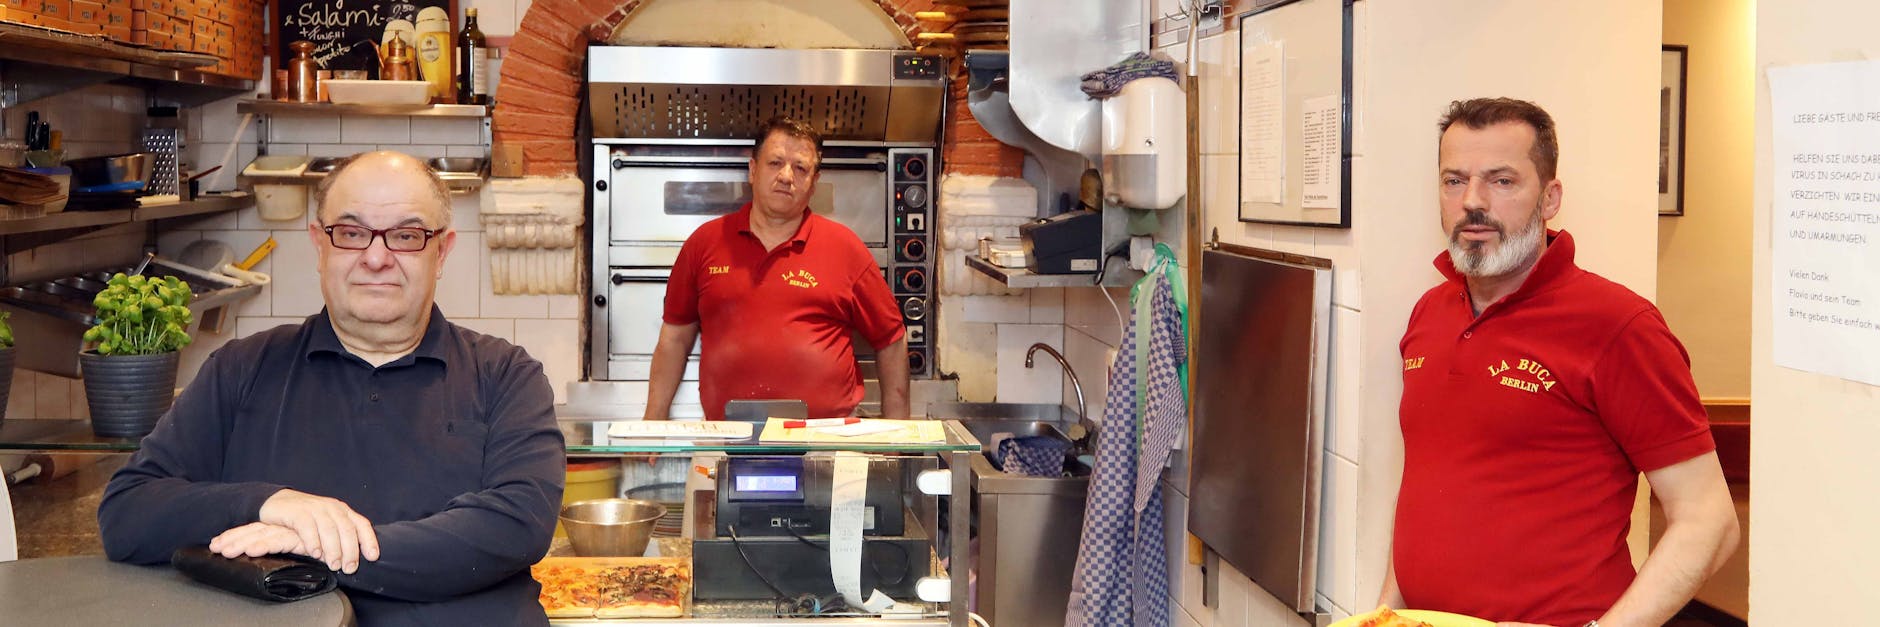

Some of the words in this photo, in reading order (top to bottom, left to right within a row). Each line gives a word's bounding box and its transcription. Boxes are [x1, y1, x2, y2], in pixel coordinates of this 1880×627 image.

[1793, 113, 1817, 124] LIEBE
[1847, 112, 1865, 122] UND
[1792, 153, 1824, 164] HELFEN
[1825, 153, 1841, 164] SIE
[1842, 154, 1860, 164] UNS
[1791, 170, 1816, 180] VIRUS
[1817, 170, 1829, 180] IN
[1830, 171, 1862, 181] SCHACH
[1863, 171, 1876, 182] ZU
[1844, 191, 1861, 203] WIR
[1790, 209, 1806, 220] AUF
[1789, 229, 1806, 240] UND
[708, 265, 730, 275] TEAM
[1789, 268, 1810, 280] Vielen
[1811, 271, 1829, 281] Dank
[782, 270, 795, 281] LA
[799, 269, 818, 288] BUCA
[789, 279, 810, 289] BERLIN
[1789, 287, 1809, 299] Flavio
[1810, 291, 1823, 302] und
[1824, 295, 1839, 304] sein
[1841, 295, 1861, 306] Team
[1789, 307, 1807, 319] Bitte
[1808, 313, 1829, 323] geben
[1831, 314, 1843, 325] Sie
[1844, 317, 1873, 329] einfach
[1404, 357, 1425, 371] TEAM
[1487, 359, 1511, 377] LA
[1517, 358, 1556, 391] BUCA
[1500, 376, 1539, 393] BERLIN
